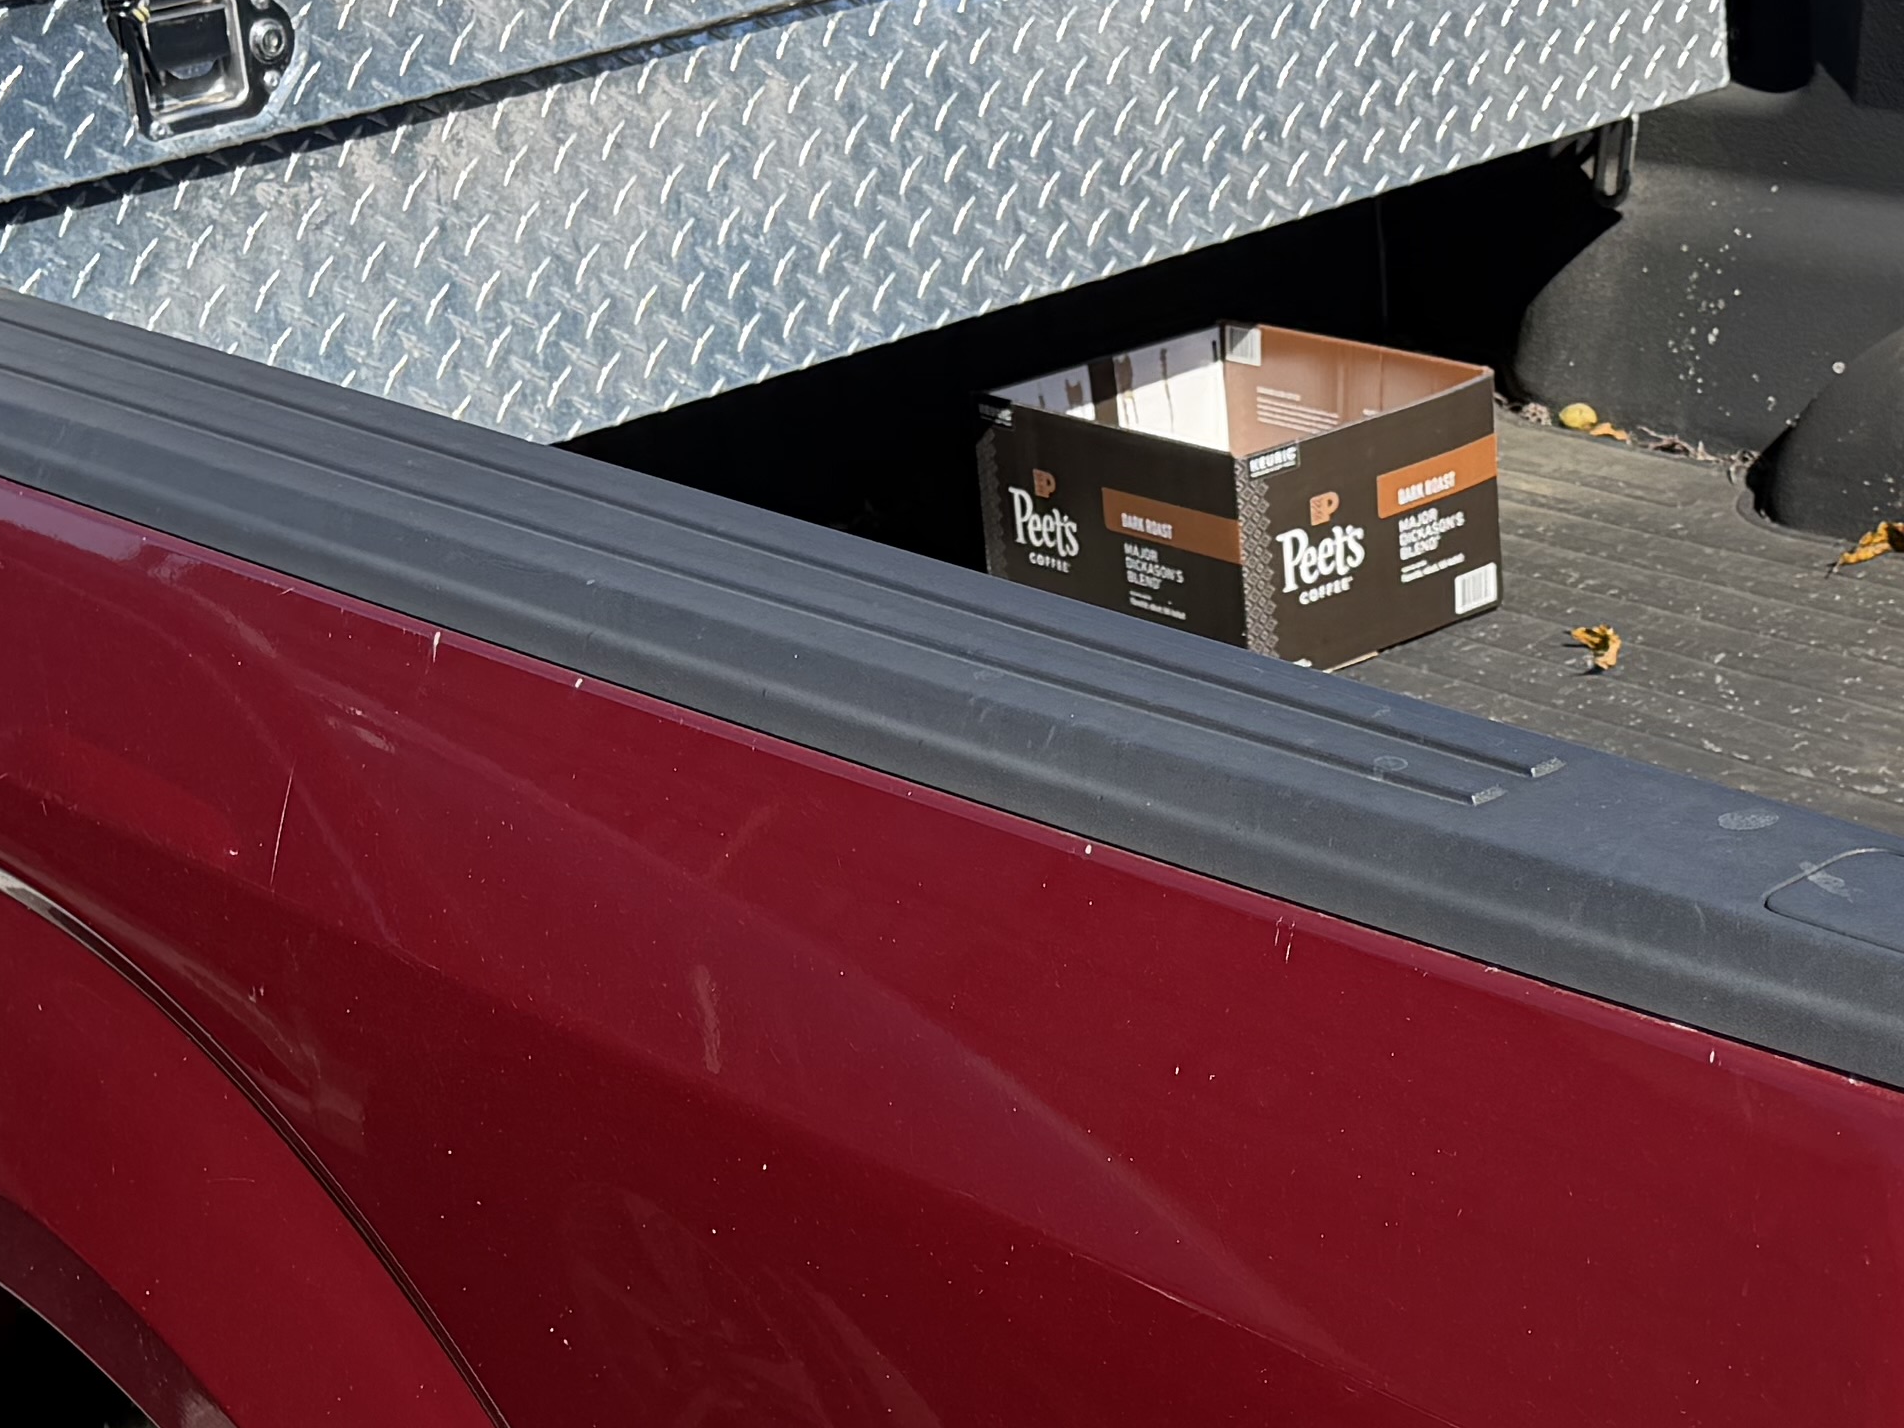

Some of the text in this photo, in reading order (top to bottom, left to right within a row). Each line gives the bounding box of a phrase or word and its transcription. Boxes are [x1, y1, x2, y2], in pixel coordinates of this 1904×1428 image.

[1008, 486, 1080, 557] Peet's
[1121, 512, 1172, 539] DARK ROAST
[1398, 507, 1438, 532] MAJOR
[1399, 511, 1465, 546] DICKASON'S
[1029, 552, 1071, 573] COFFEE
[1124, 542, 1158, 562] MAJOR
[1275, 525, 1366, 593] Peet's
[1125, 556, 1185, 583] DICKASON'S
[1299, 576, 1353, 604] COFFEE
